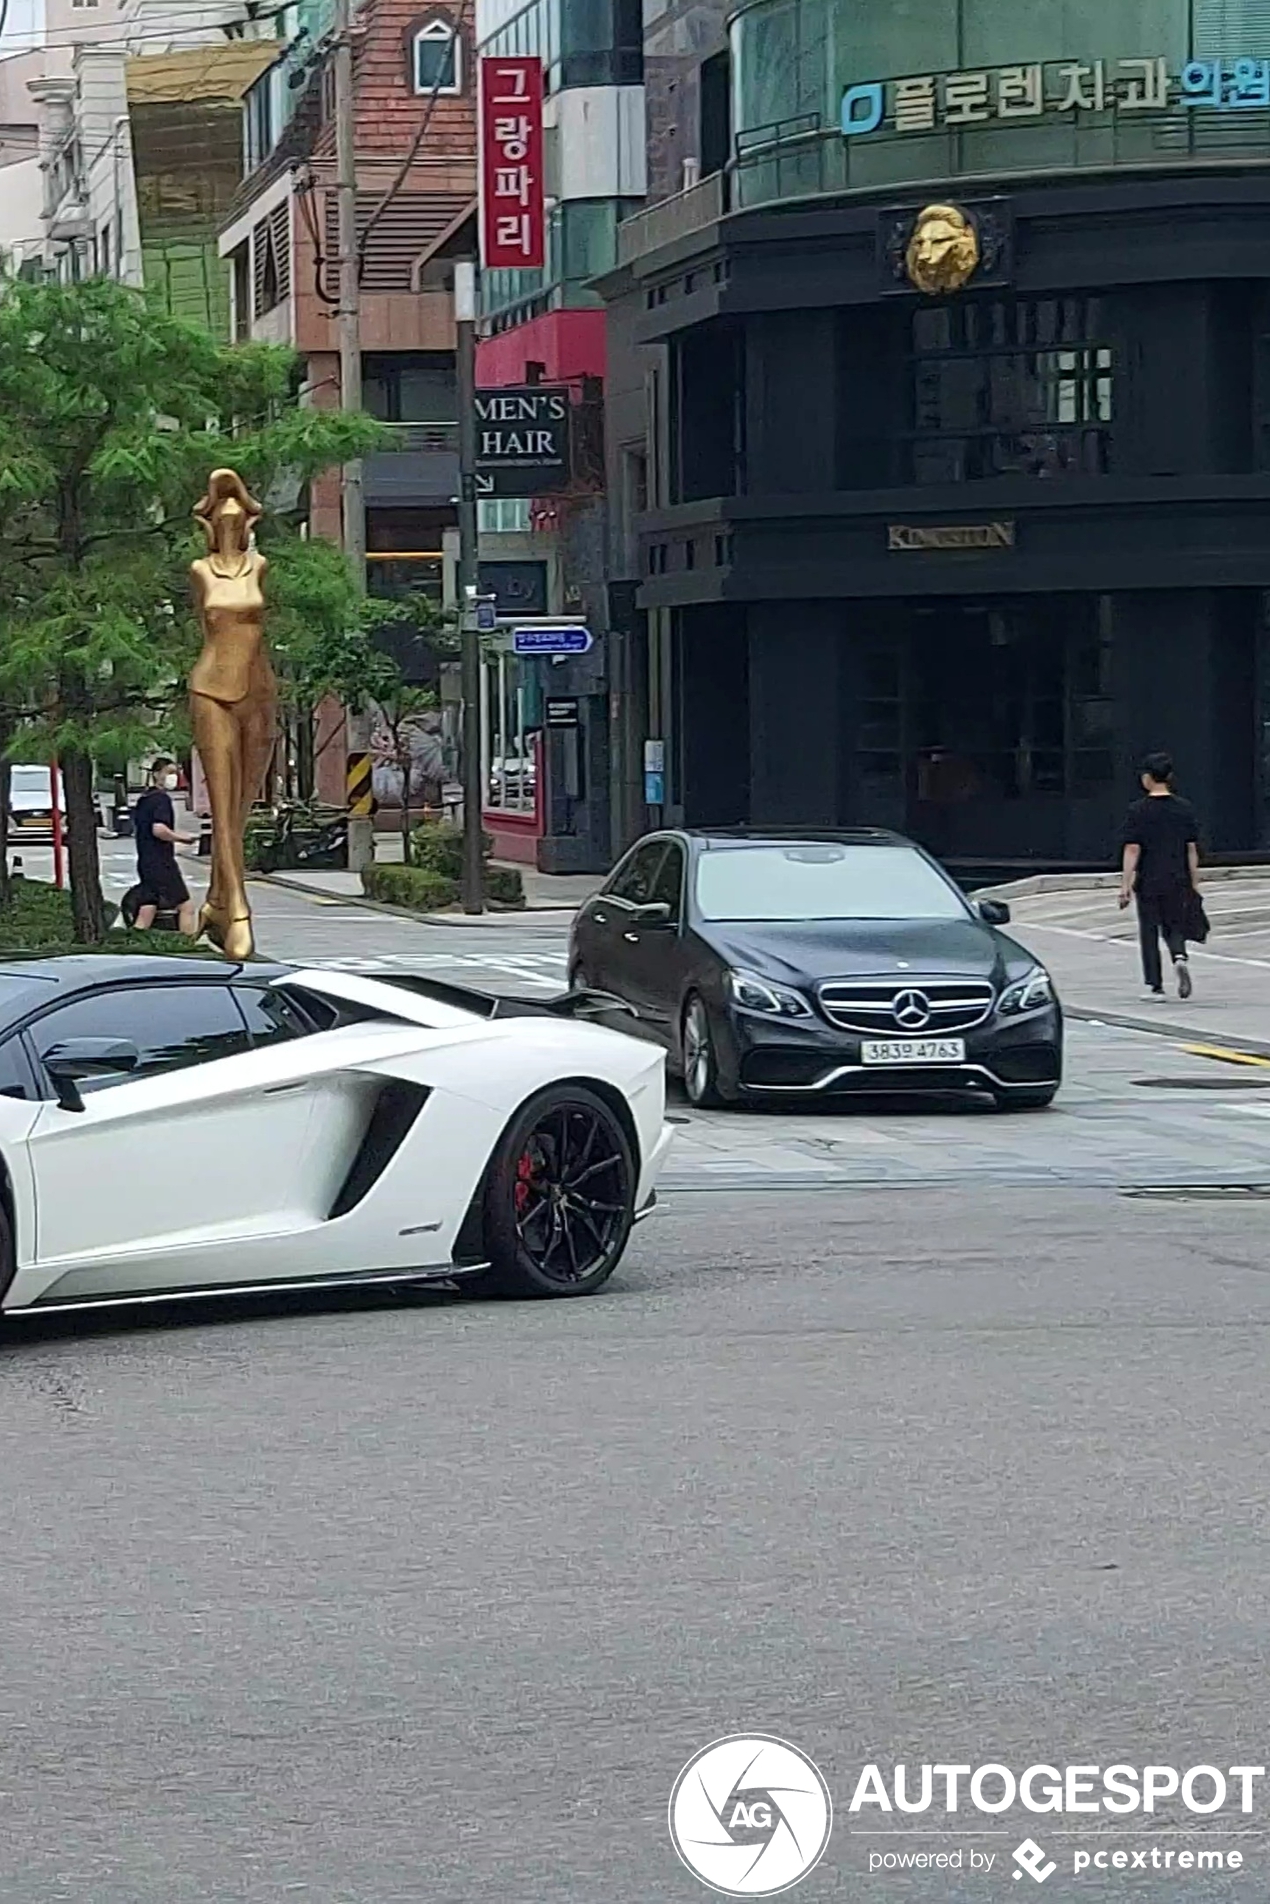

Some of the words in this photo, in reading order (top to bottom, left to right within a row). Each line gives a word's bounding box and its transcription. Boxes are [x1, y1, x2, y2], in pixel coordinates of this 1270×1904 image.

[492, 69, 535, 256] 그랑파리
[474, 395, 565, 420] MEN'S
[481, 430, 557, 454] HAIR
